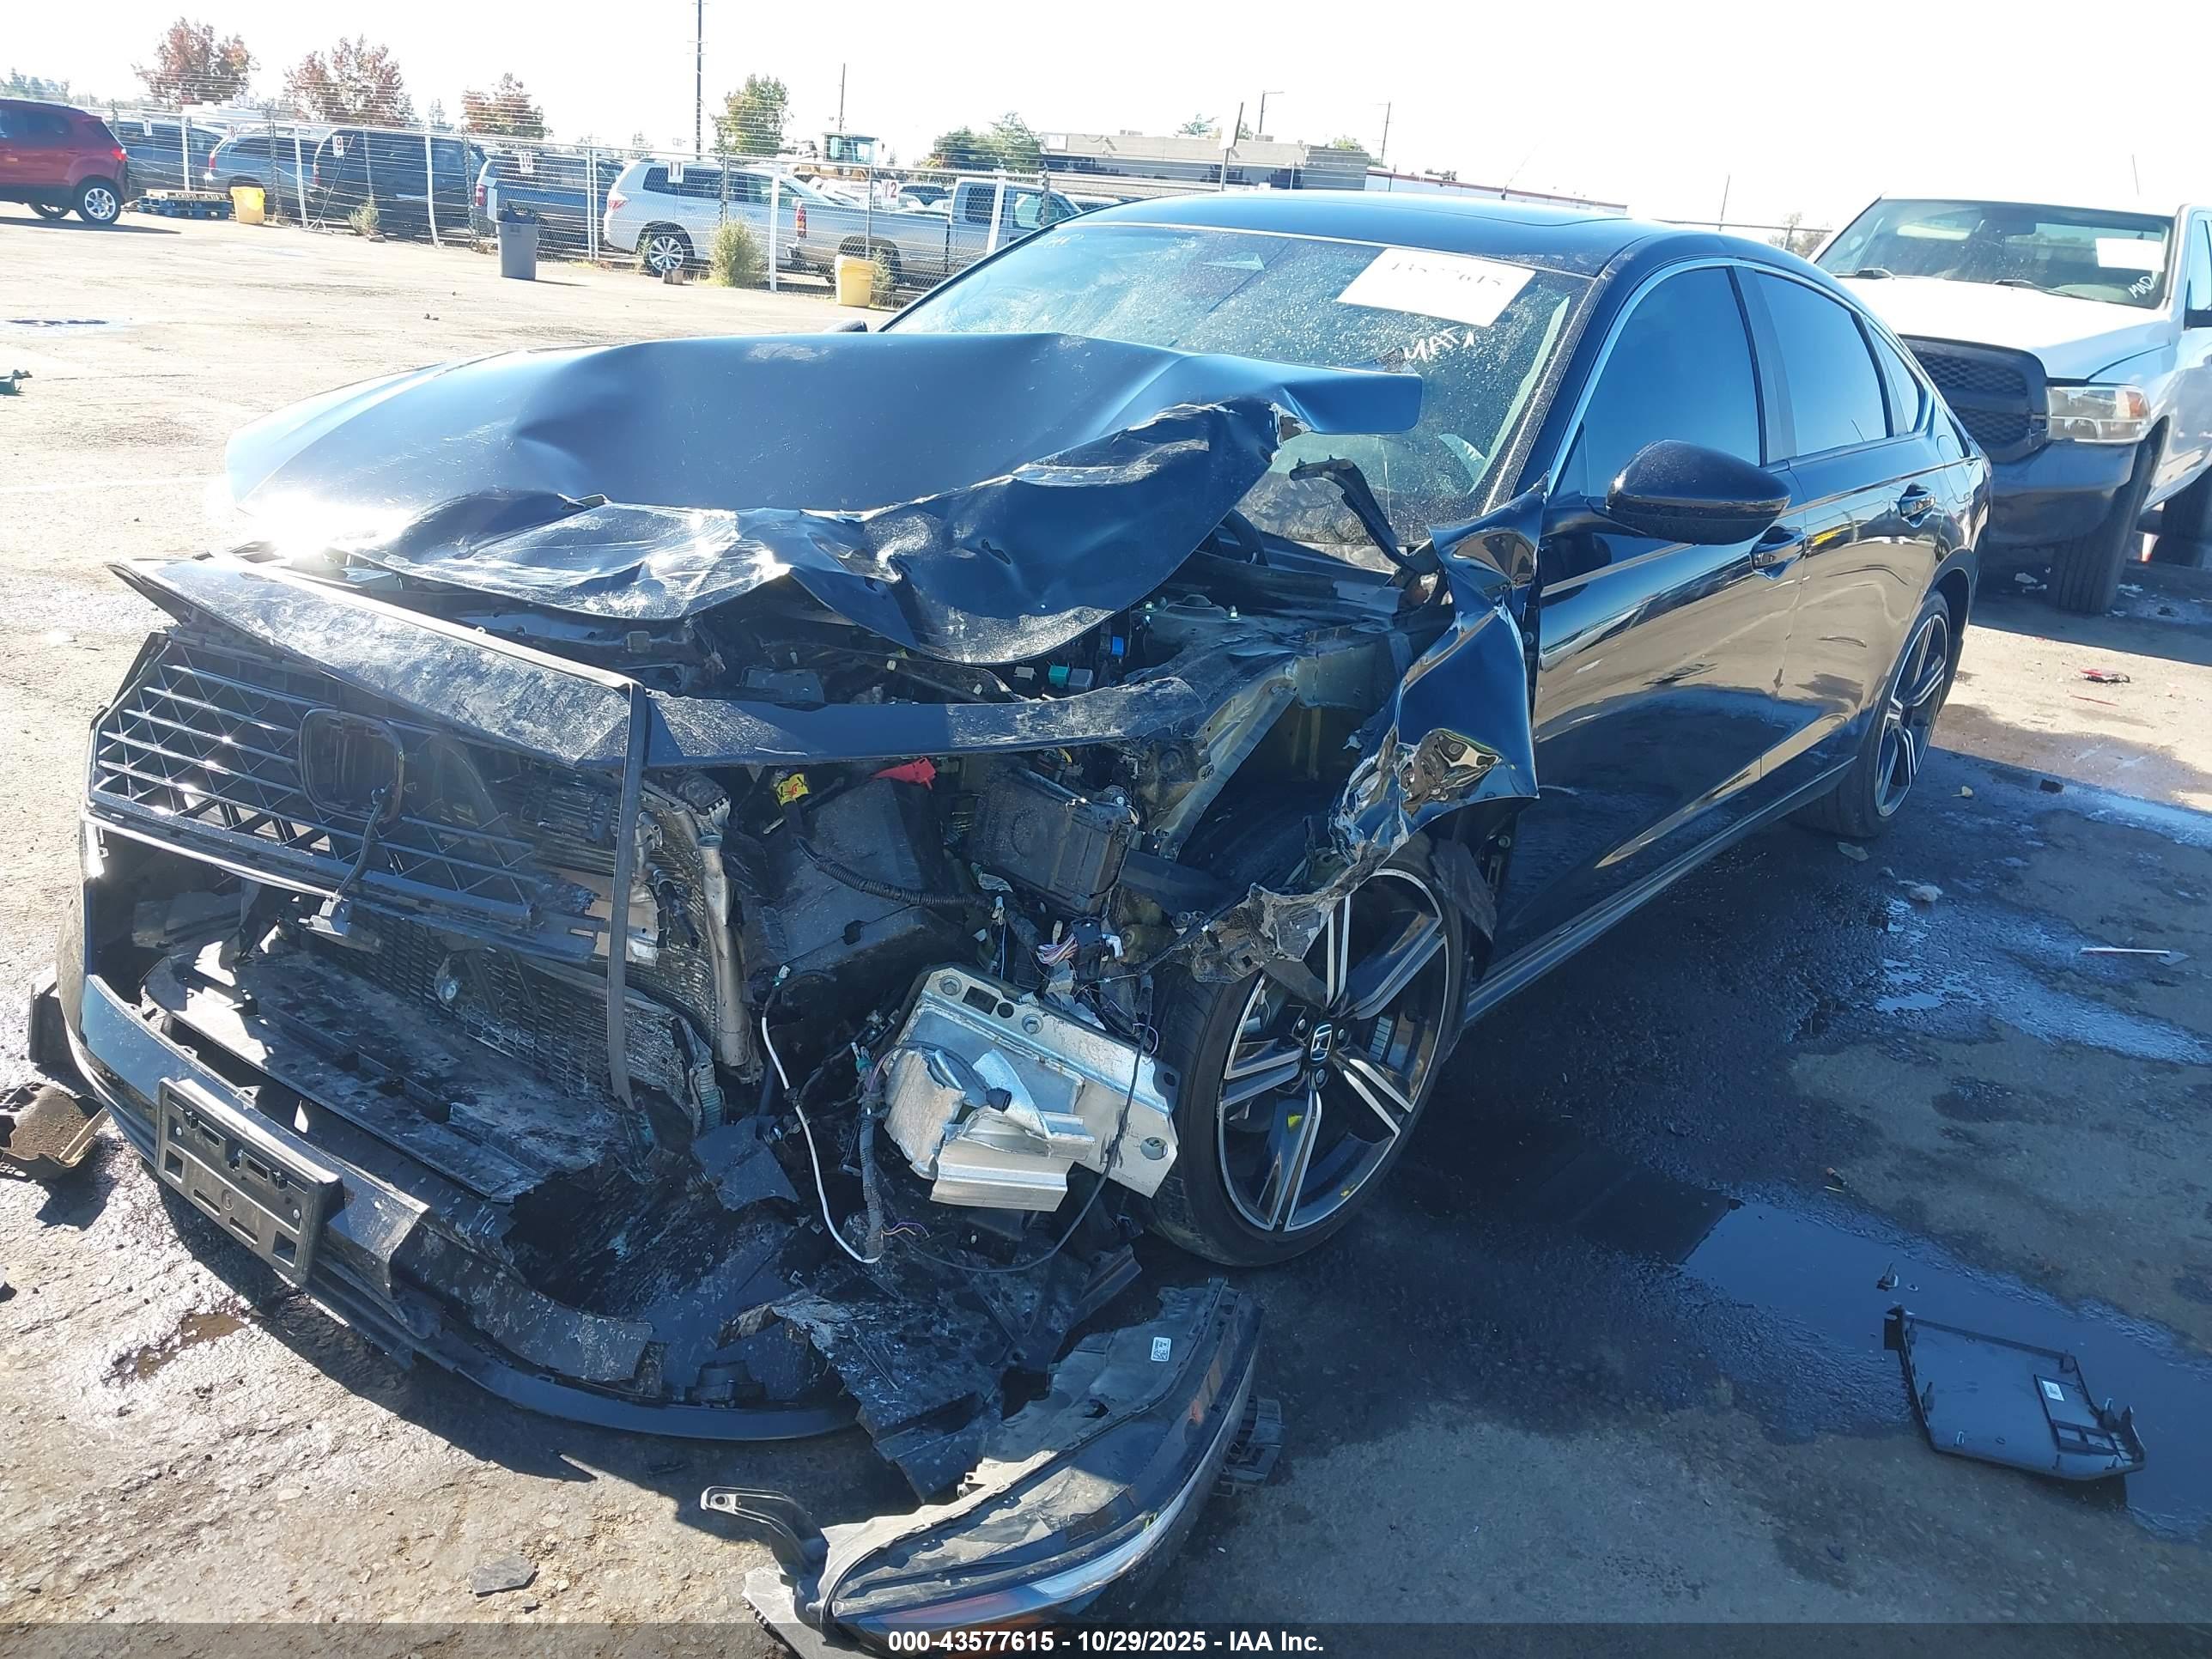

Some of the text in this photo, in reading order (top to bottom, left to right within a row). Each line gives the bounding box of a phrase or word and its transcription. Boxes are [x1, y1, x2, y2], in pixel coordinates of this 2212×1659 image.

[336, 137, 343, 150] 9
[520, 152, 532, 168] 10
[884, 181, 897, 198] 12
[2127, 276, 2155, 299] MAD
